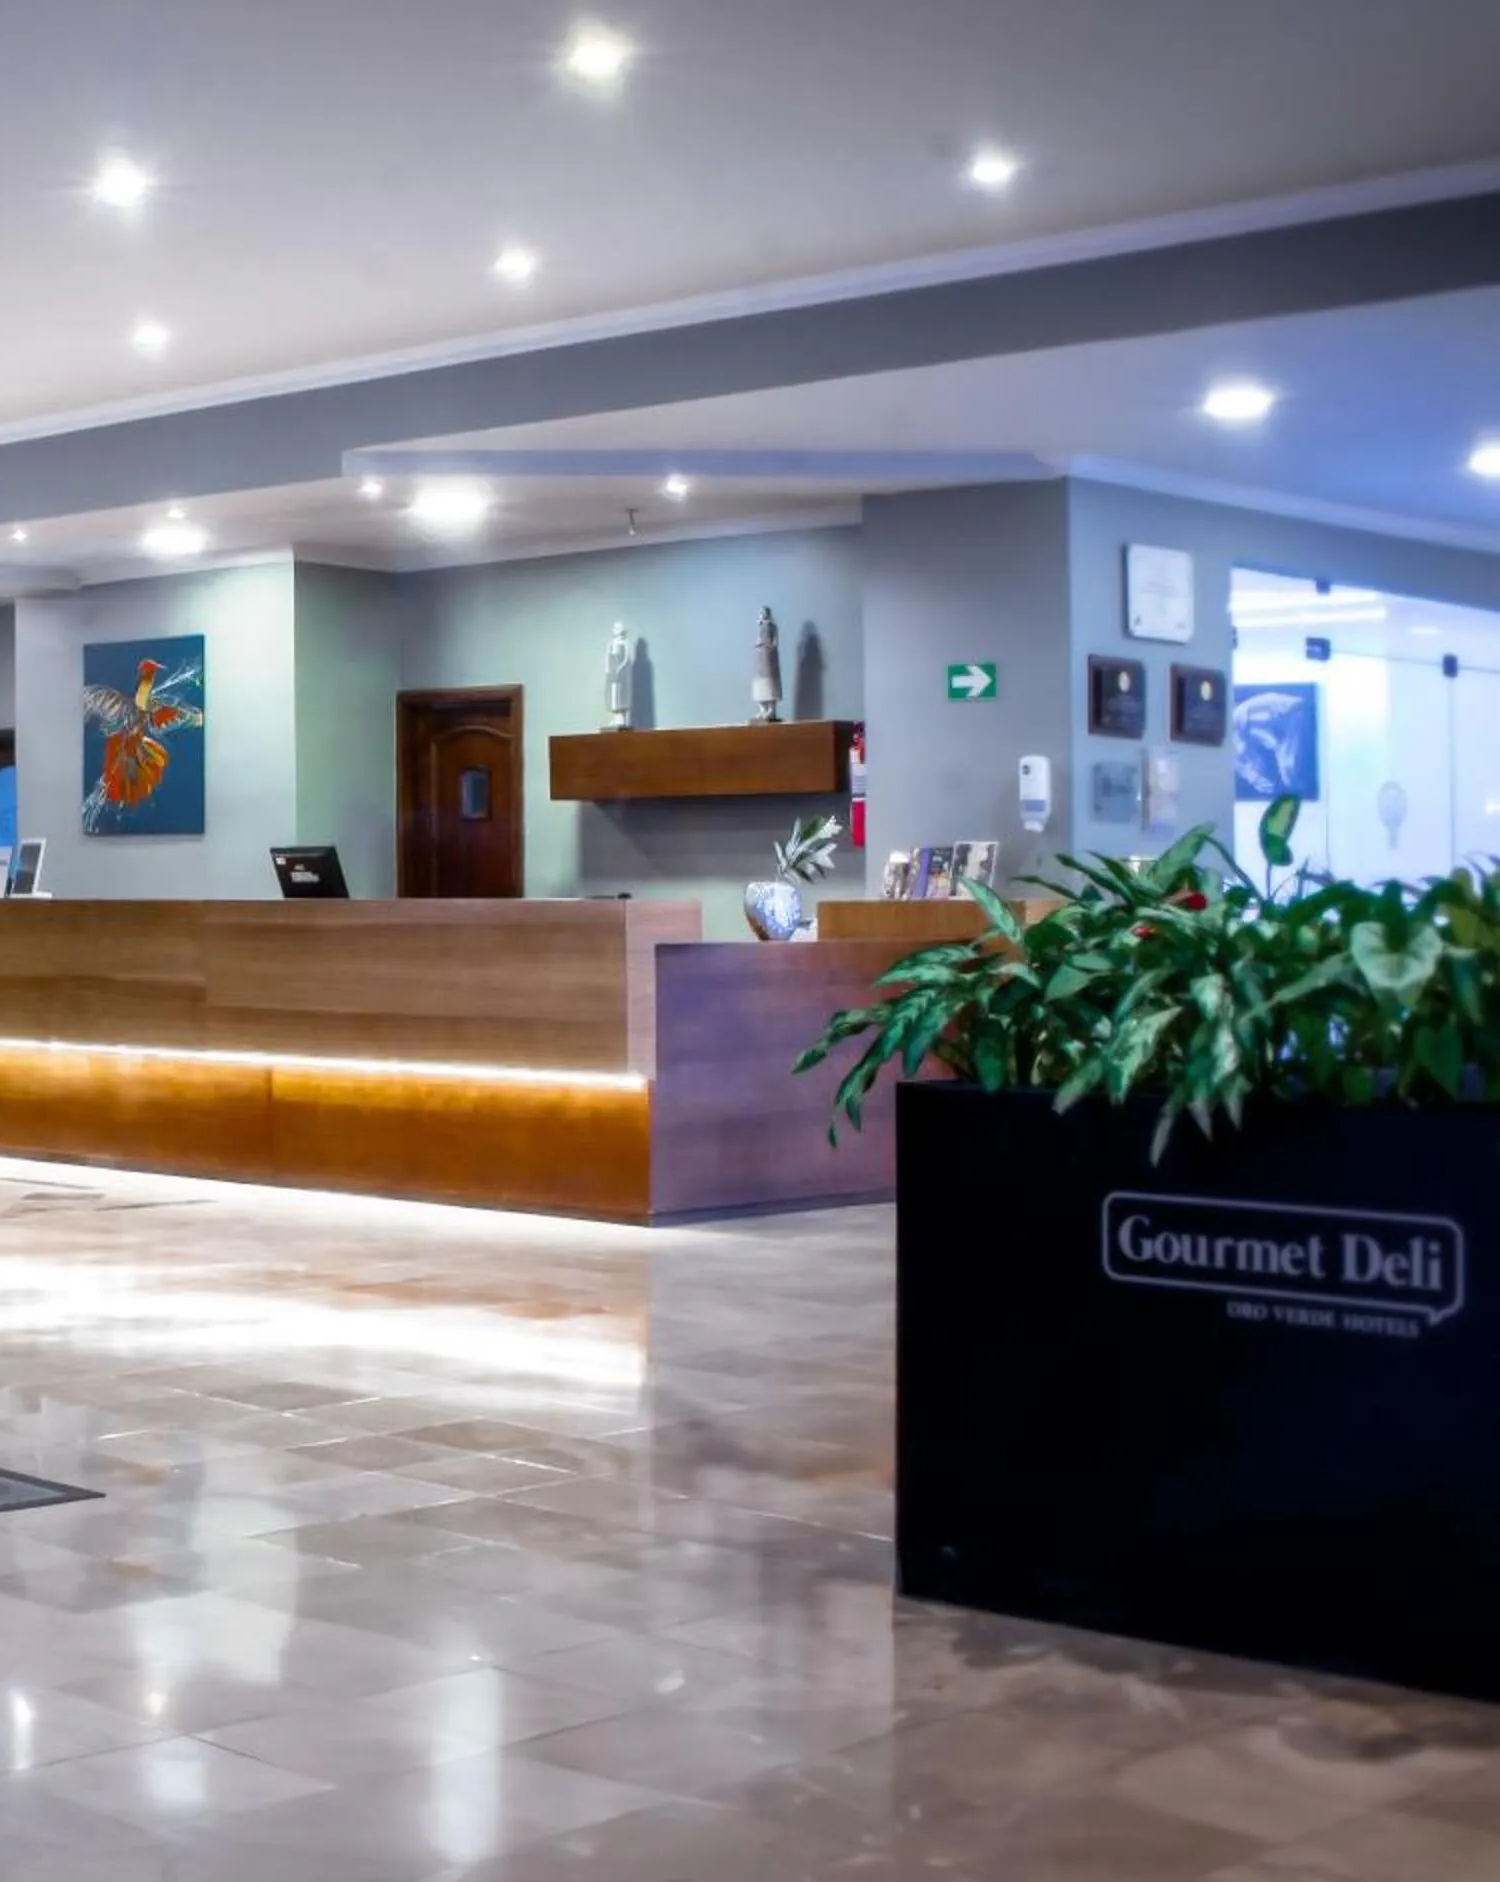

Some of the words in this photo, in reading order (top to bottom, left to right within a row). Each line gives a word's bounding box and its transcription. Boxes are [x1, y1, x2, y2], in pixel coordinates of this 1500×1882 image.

[1117, 1214, 1326, 1279] Gourmet
[1340, 1233, 1442, 1291] Deli
[1272, 1305, 1336, 1329] VERDE
[1343, 1312, 1420, 1338] HOTELS
